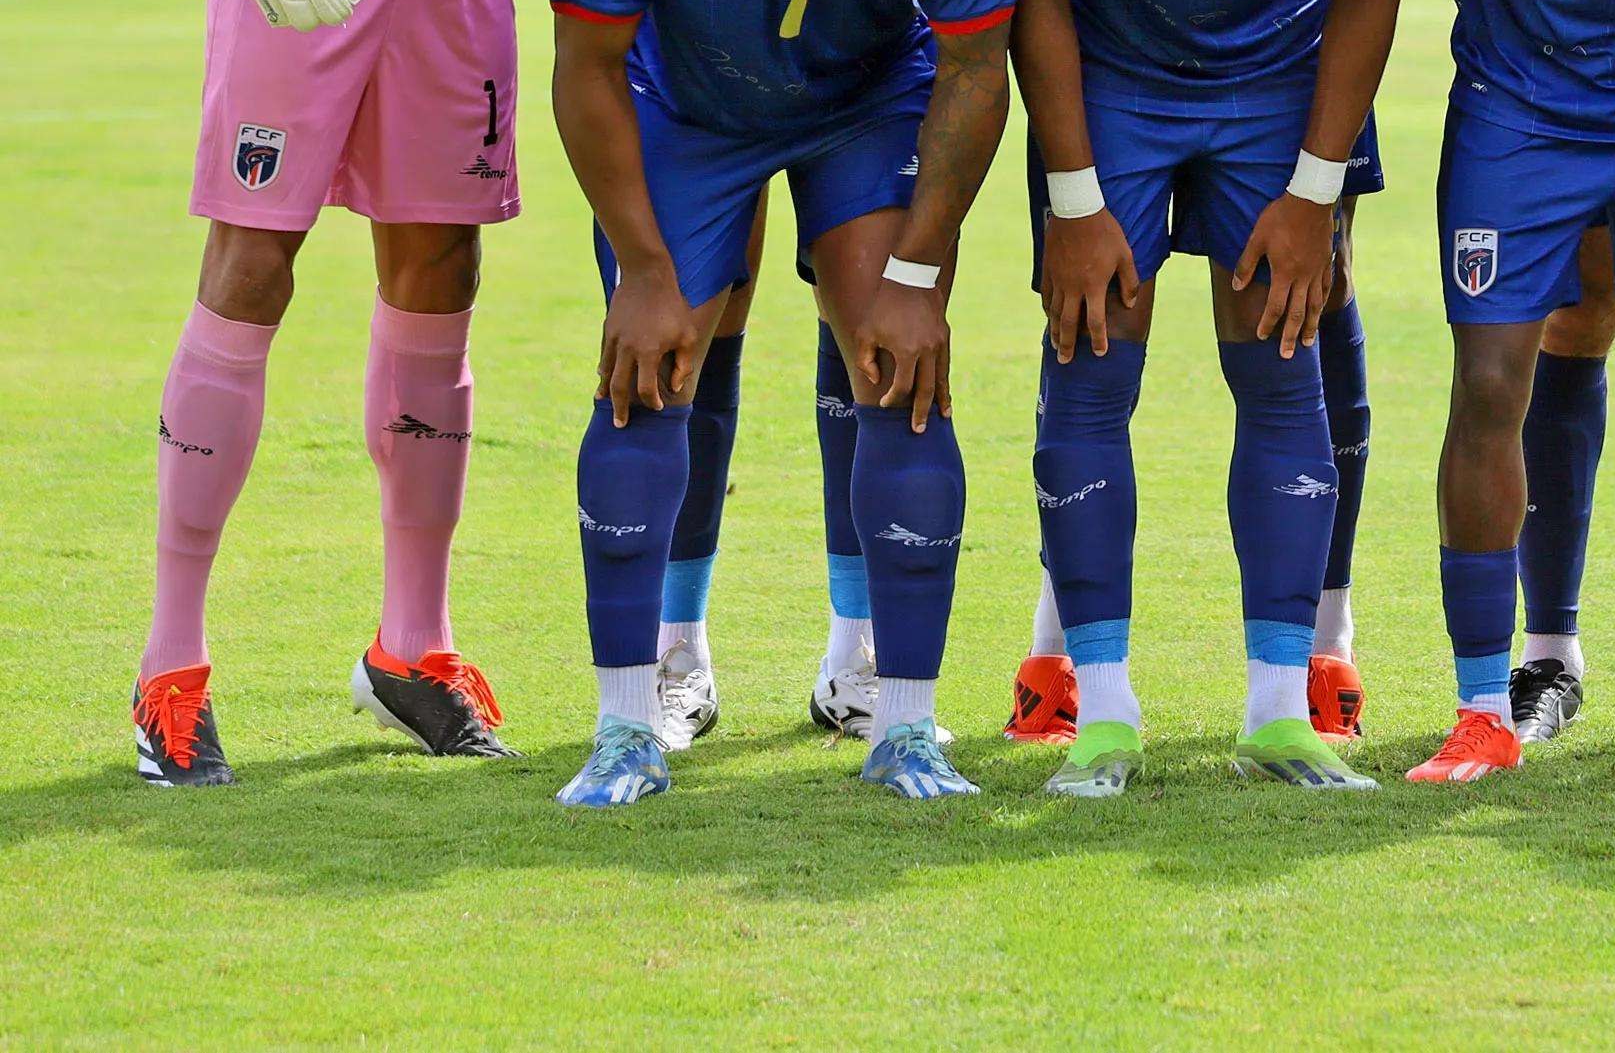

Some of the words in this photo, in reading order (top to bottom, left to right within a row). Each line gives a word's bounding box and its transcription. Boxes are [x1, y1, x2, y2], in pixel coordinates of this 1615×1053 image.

[482, 79, 499, 147] 1
[240, 126, 283, 142] FCF
[1457, 233, 1494, 244] FCF
[1040, 480, 1107, 508] tempo
[584, 520, 648, 537] tempo
